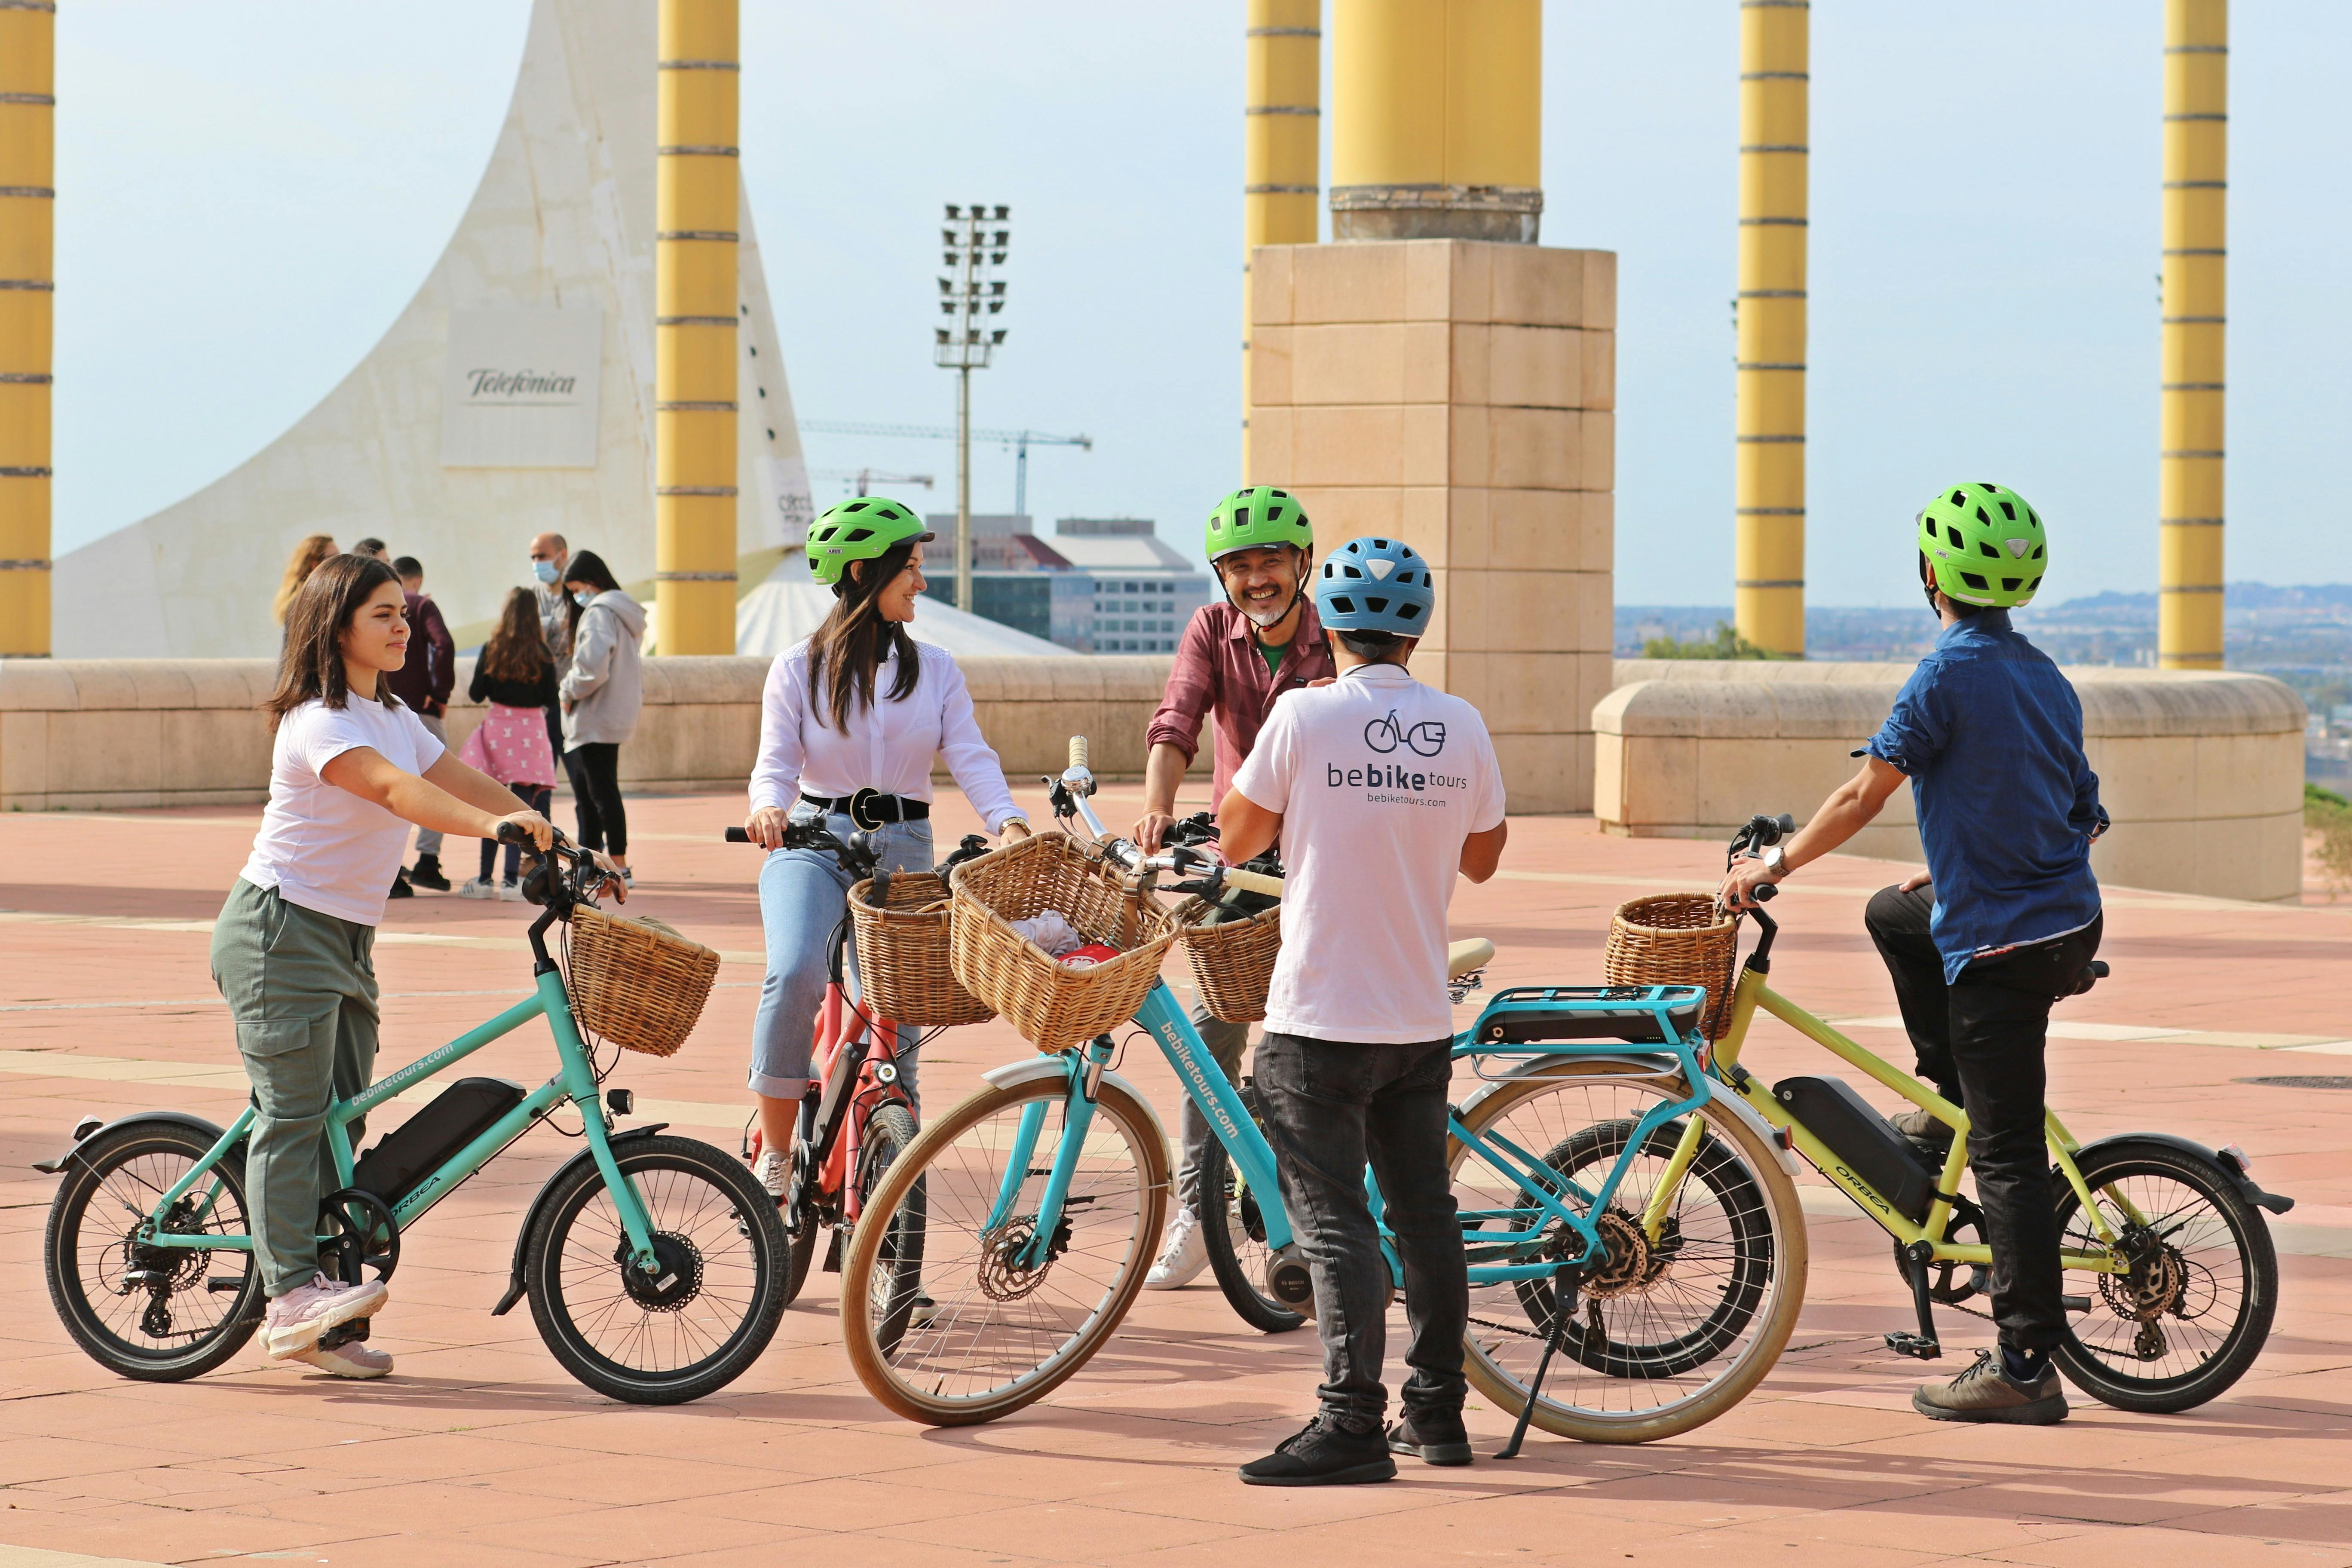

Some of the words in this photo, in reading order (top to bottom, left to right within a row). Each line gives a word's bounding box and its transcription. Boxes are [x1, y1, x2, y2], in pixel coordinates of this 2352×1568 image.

[1367, 793, 1446, 807] bebiketours.com
[352, 1044, 454, 1106] bebiketours.com
[1161, 1021, 1238, 1139] bebiketours.com
[1836, 1166, 1890, 1215] ORBEA
[1479, 1232, 1498, 1240] RIDE
